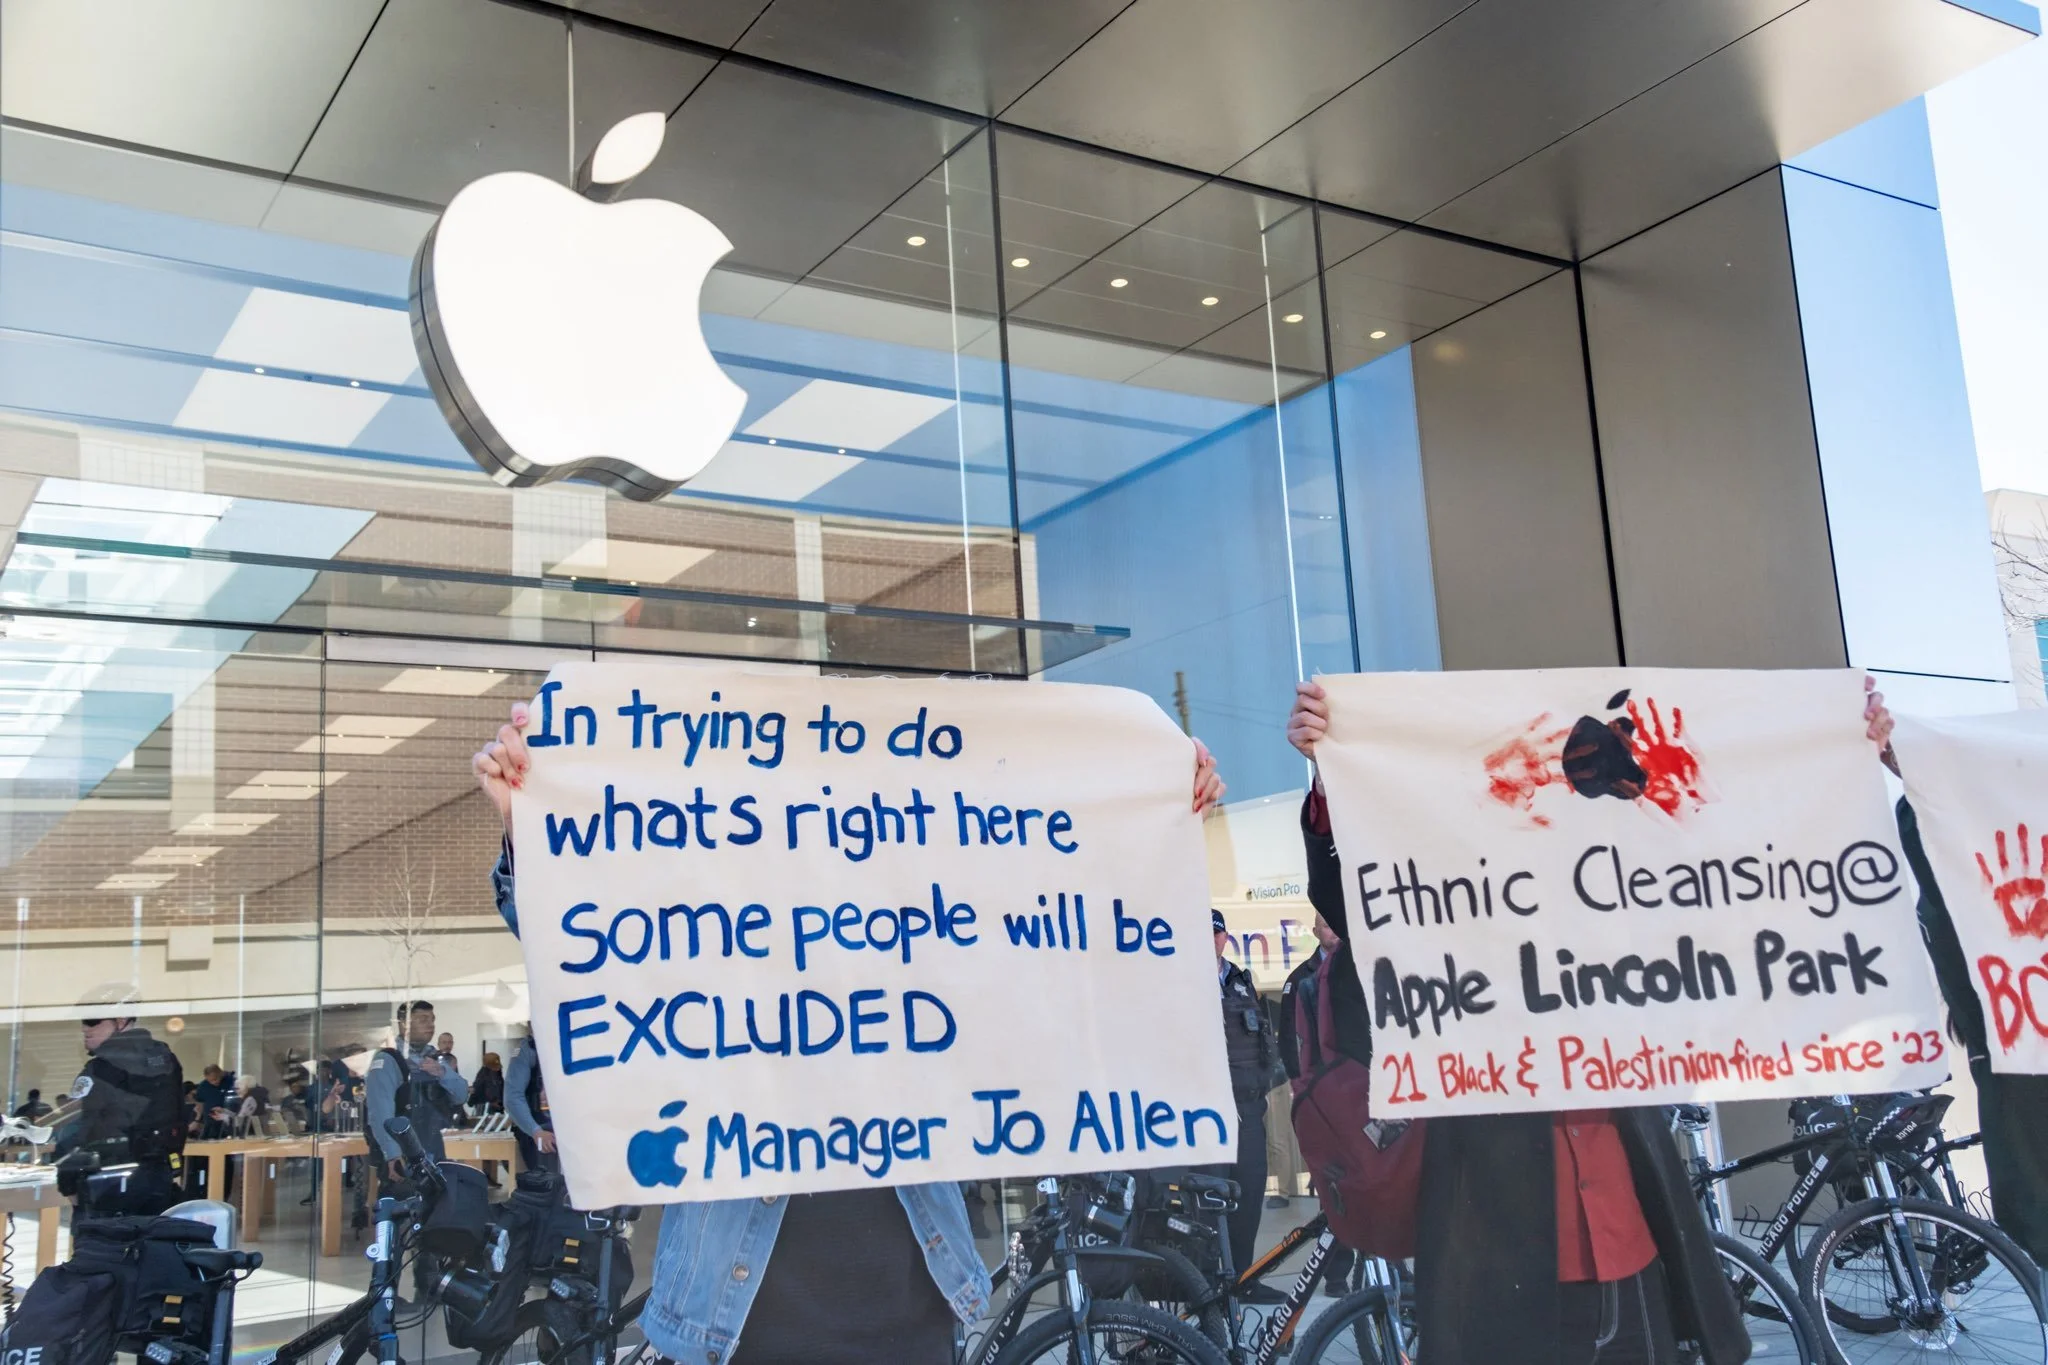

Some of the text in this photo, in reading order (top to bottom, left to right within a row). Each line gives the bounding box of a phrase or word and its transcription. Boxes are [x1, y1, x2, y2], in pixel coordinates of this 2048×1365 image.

[528, 681, 962, 769] In trying to do
[546, 785, 1078, 862] whats right here
[561, 883, 1175, 974] Some people will be
[1252, 882, 1300, 900] Vision Pro
[1358, 859, 1537, 930] Ethnic
[1374, 930, 1887, 1038] Apple Lincoln Park
[558, 989, 957, 1075] EXCLUDED
[1382, 1053, 1427, 1104] 21
[1438, 1052, 1507, 1098] Black
[1516, 1037, 1538, 1097] &
[1802, 1034, 1884, 1072] since
[1892, 1031, 1943, 1064] '23
[704, 1089, 1227, 1179] Manager Jo Allen
[1895, 1120, 1918, 1141] POLICE
[1786, 1166, 1820, 1214] POLICE
[1290, 1247, 1325, 1304] POLICE
